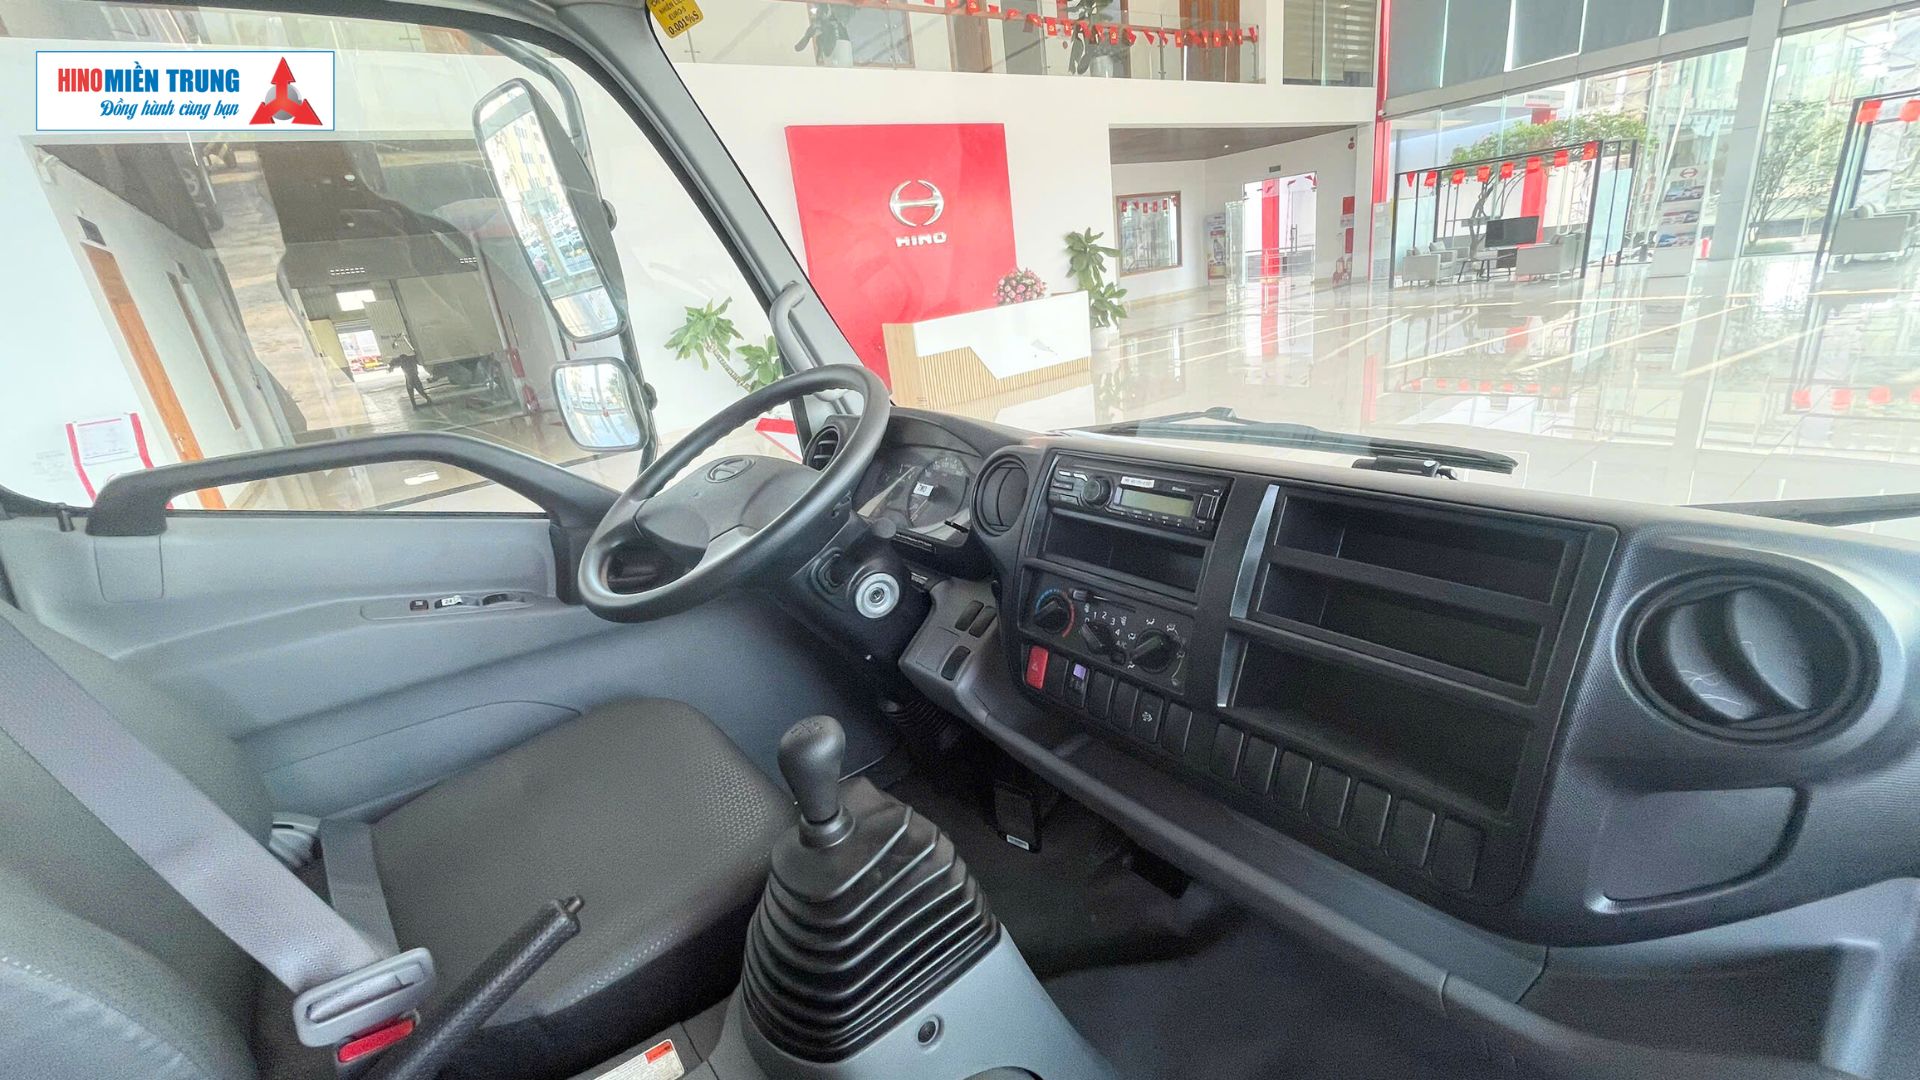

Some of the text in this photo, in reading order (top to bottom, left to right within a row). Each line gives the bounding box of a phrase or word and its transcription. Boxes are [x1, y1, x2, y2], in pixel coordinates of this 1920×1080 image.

[668, 10, 699, 35] 0.001%S
[896, 231, 947, 247] HINO
[1093, 611, 1097, 620] 1
[1102, 611, 1107, 620] 2
[1110, 617, 1116, 626] 3
[1115, 628, 1121, 636] 4
[1116, 640, 1127, 649] A/C
